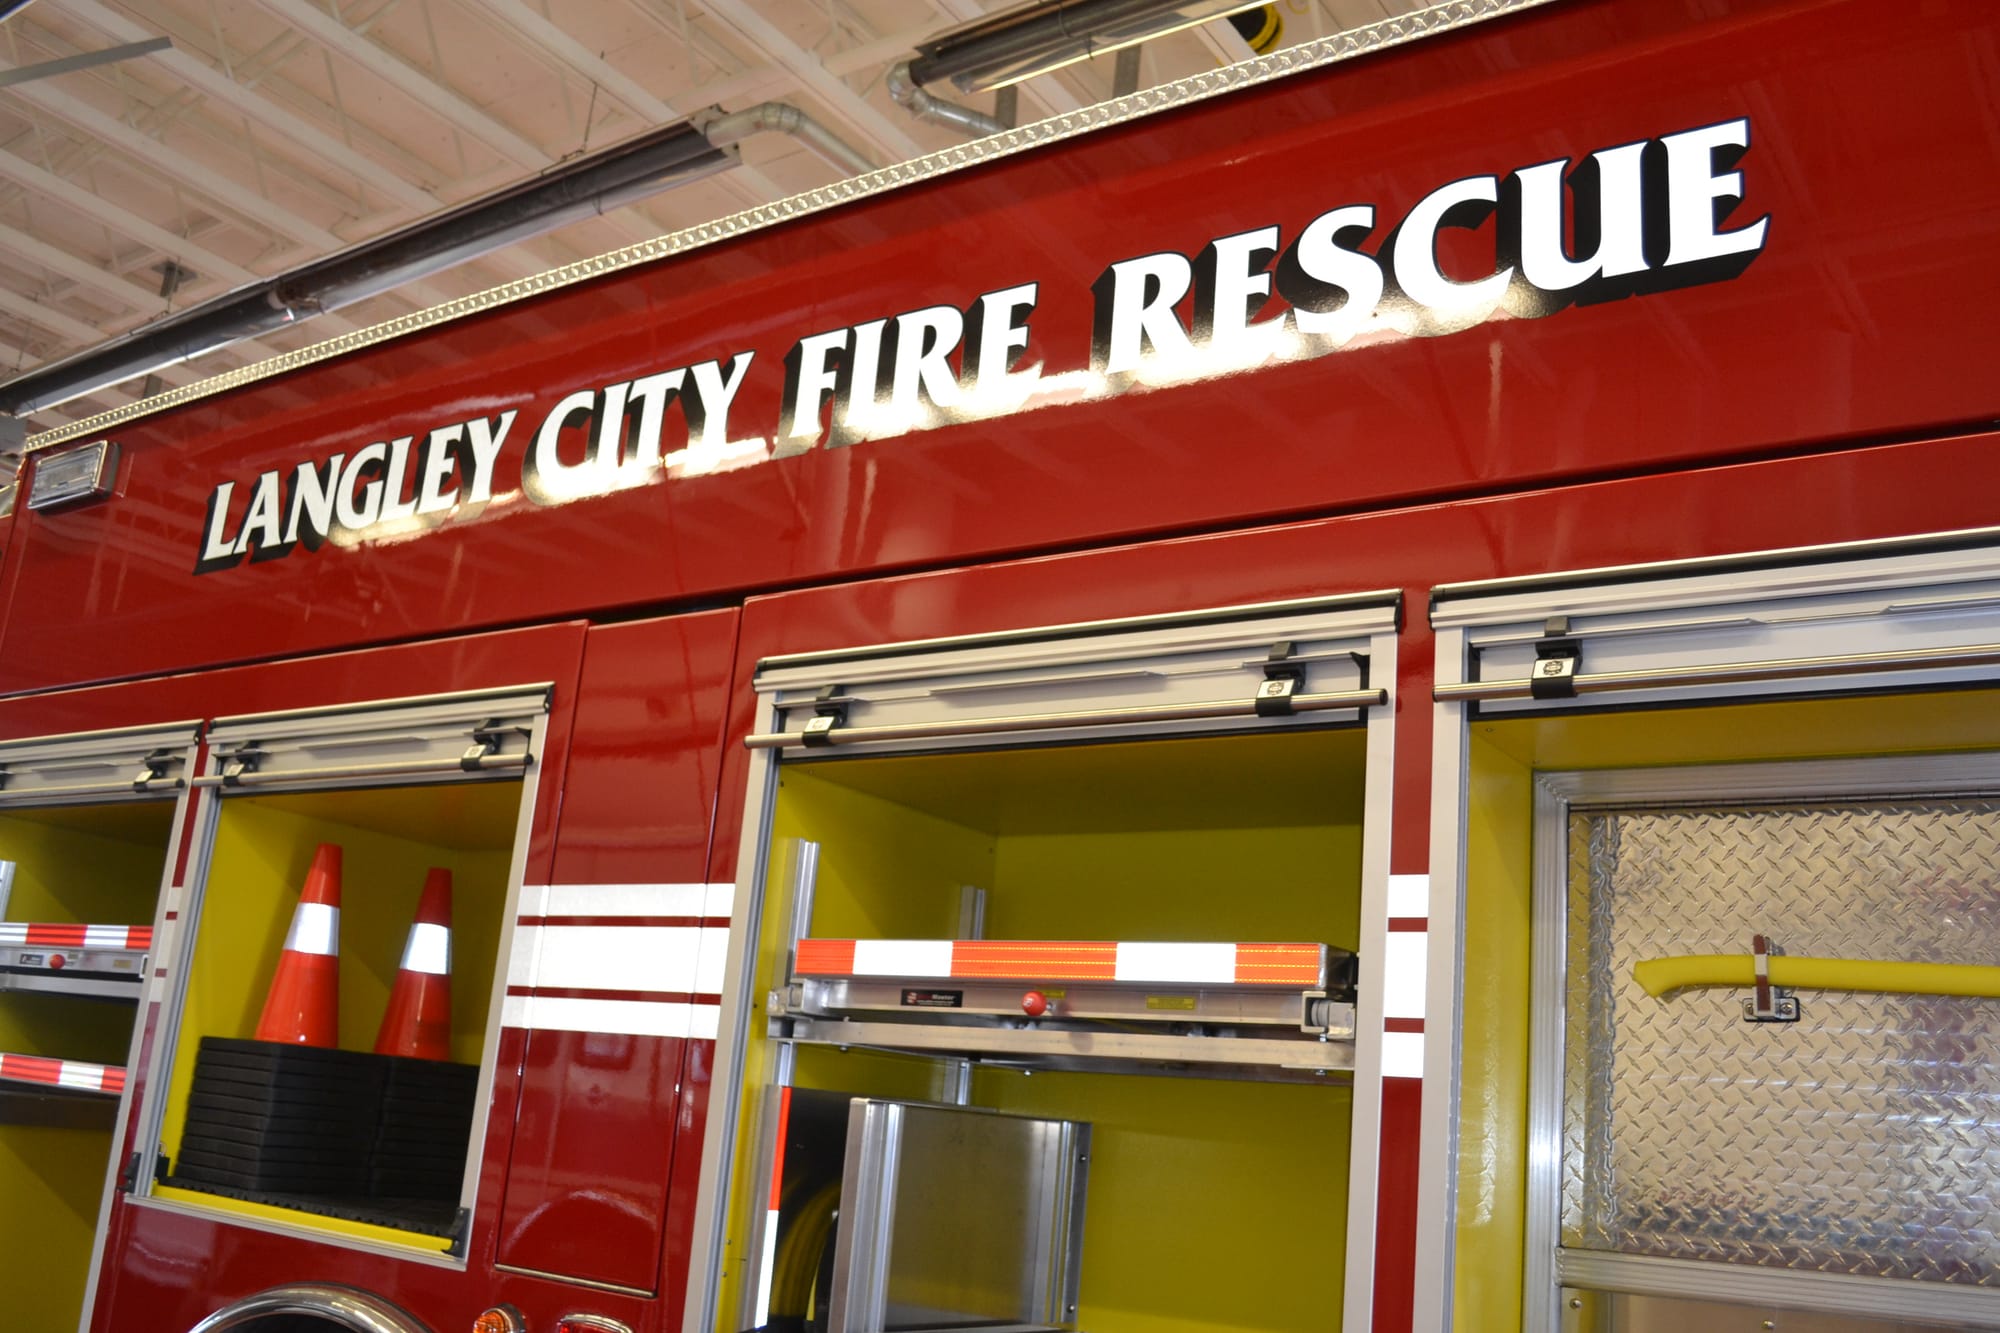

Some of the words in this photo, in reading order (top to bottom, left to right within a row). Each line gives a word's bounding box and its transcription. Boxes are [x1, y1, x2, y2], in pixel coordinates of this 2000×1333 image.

[198, 410, 518, 566] LANGLEY
[526, 351, 757, 500] CITY
[782, 283, 1042, 440] FIRE
[1098, 117, 1770, 376] RESCUE
